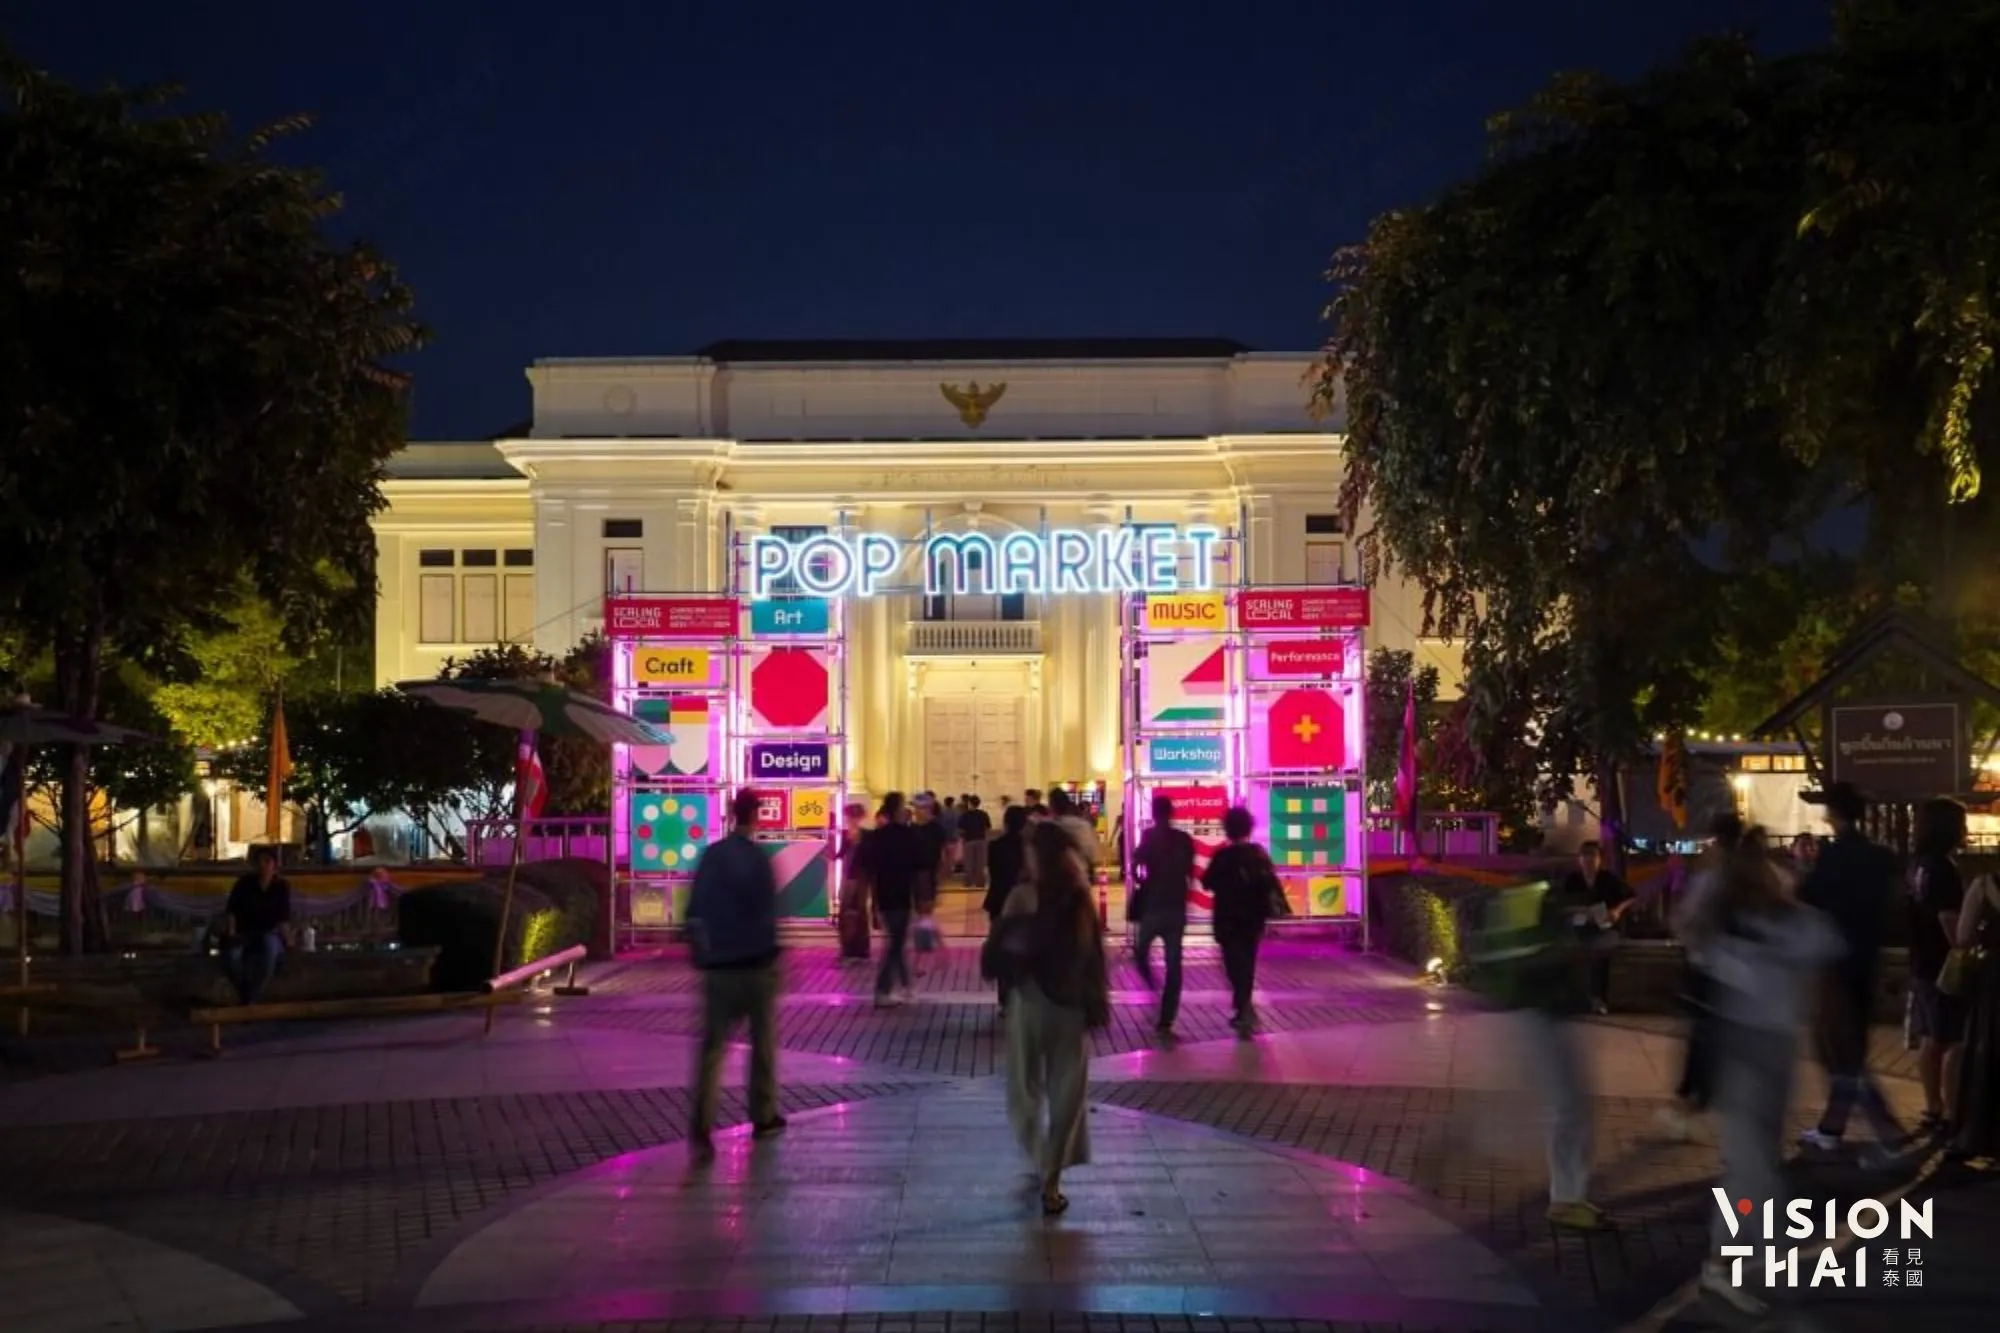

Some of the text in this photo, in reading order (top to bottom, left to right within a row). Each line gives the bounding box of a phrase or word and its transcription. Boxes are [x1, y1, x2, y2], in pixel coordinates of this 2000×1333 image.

[751, 528, 1218, 599] POP MARKET
[1152, 602, 1216, 619] MUSIC
[1245, 599, 1293, 610] SCALING
[774, 610, 803, 625] Art
[645, 657, 694, 674] Craft
[1271, 652, 1340, 662] Performance
[761, 752, 821, 772] Design
[1153, 745, 1222, 763] Workshop
